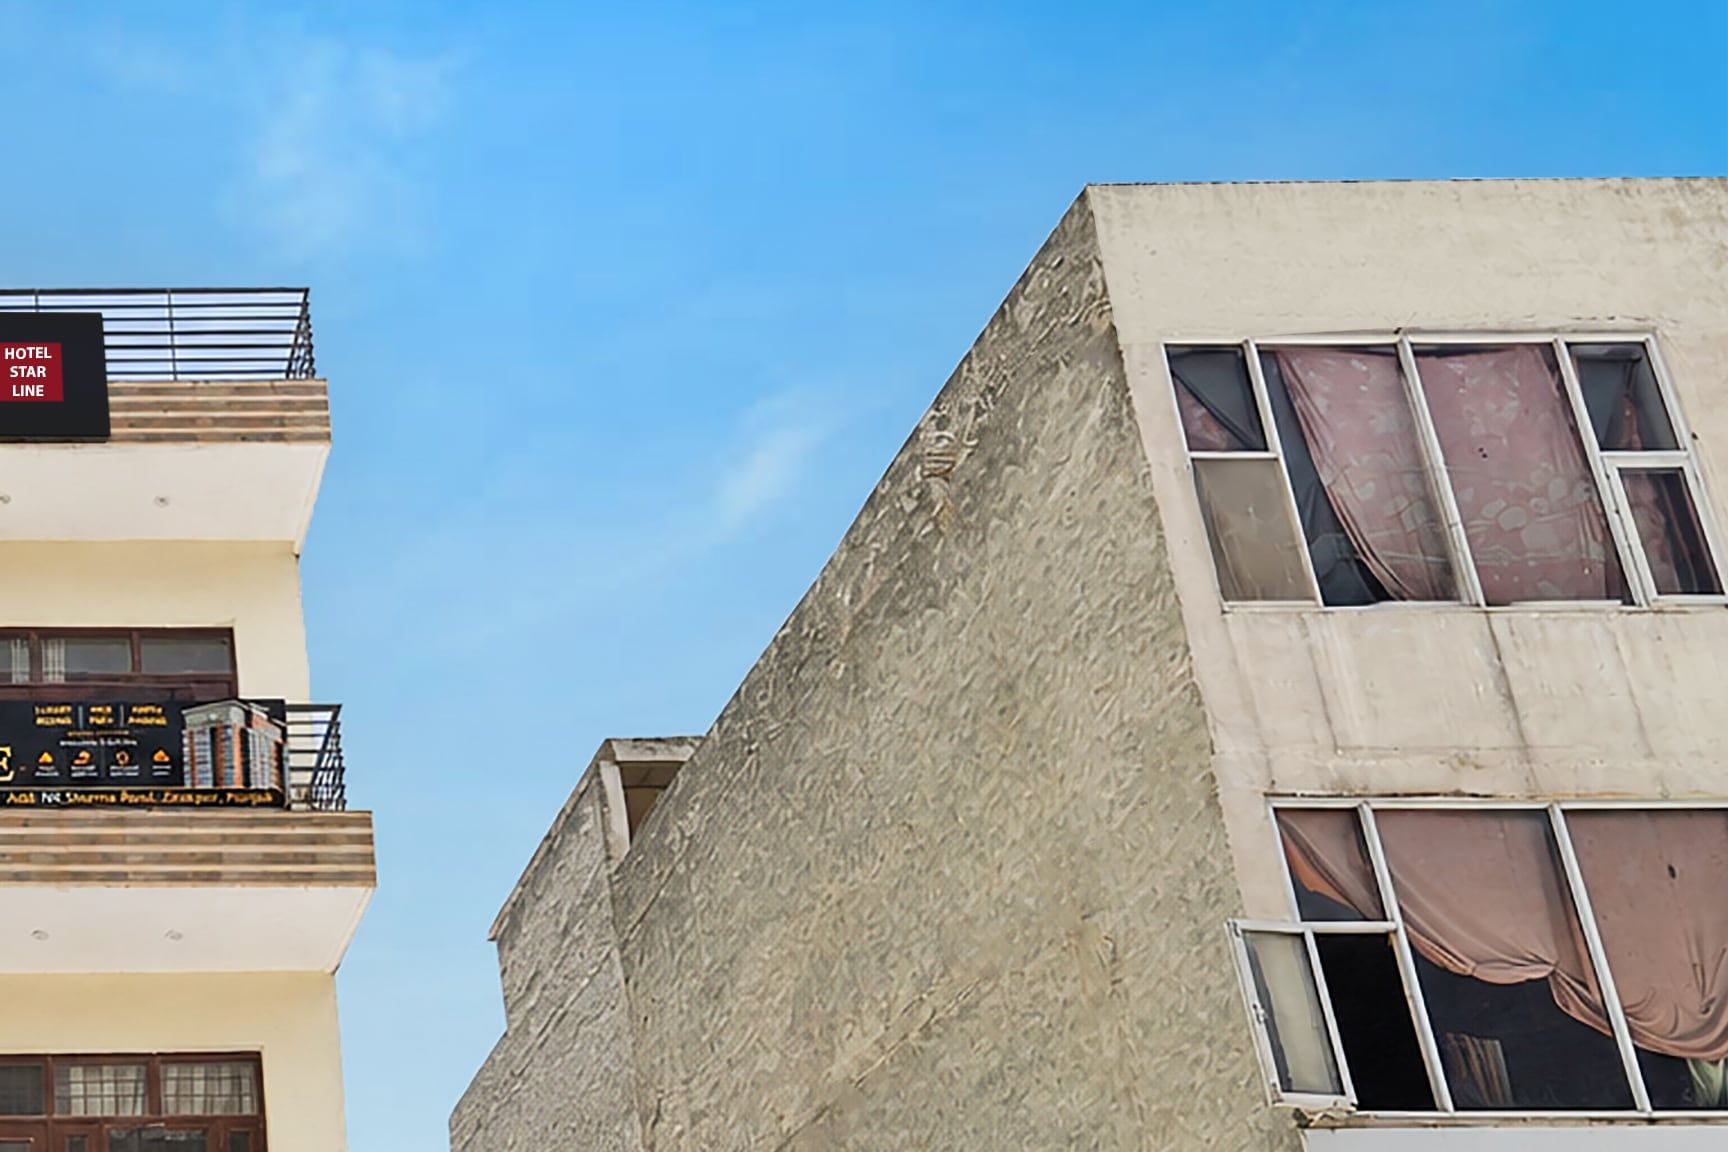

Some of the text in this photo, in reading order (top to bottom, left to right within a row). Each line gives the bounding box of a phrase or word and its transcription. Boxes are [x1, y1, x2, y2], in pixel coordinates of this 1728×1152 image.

[4, 346, 53, 361] HOTEL
[9, 365, 47, 379] STAR
[12, 384, 45, 398] LINE
